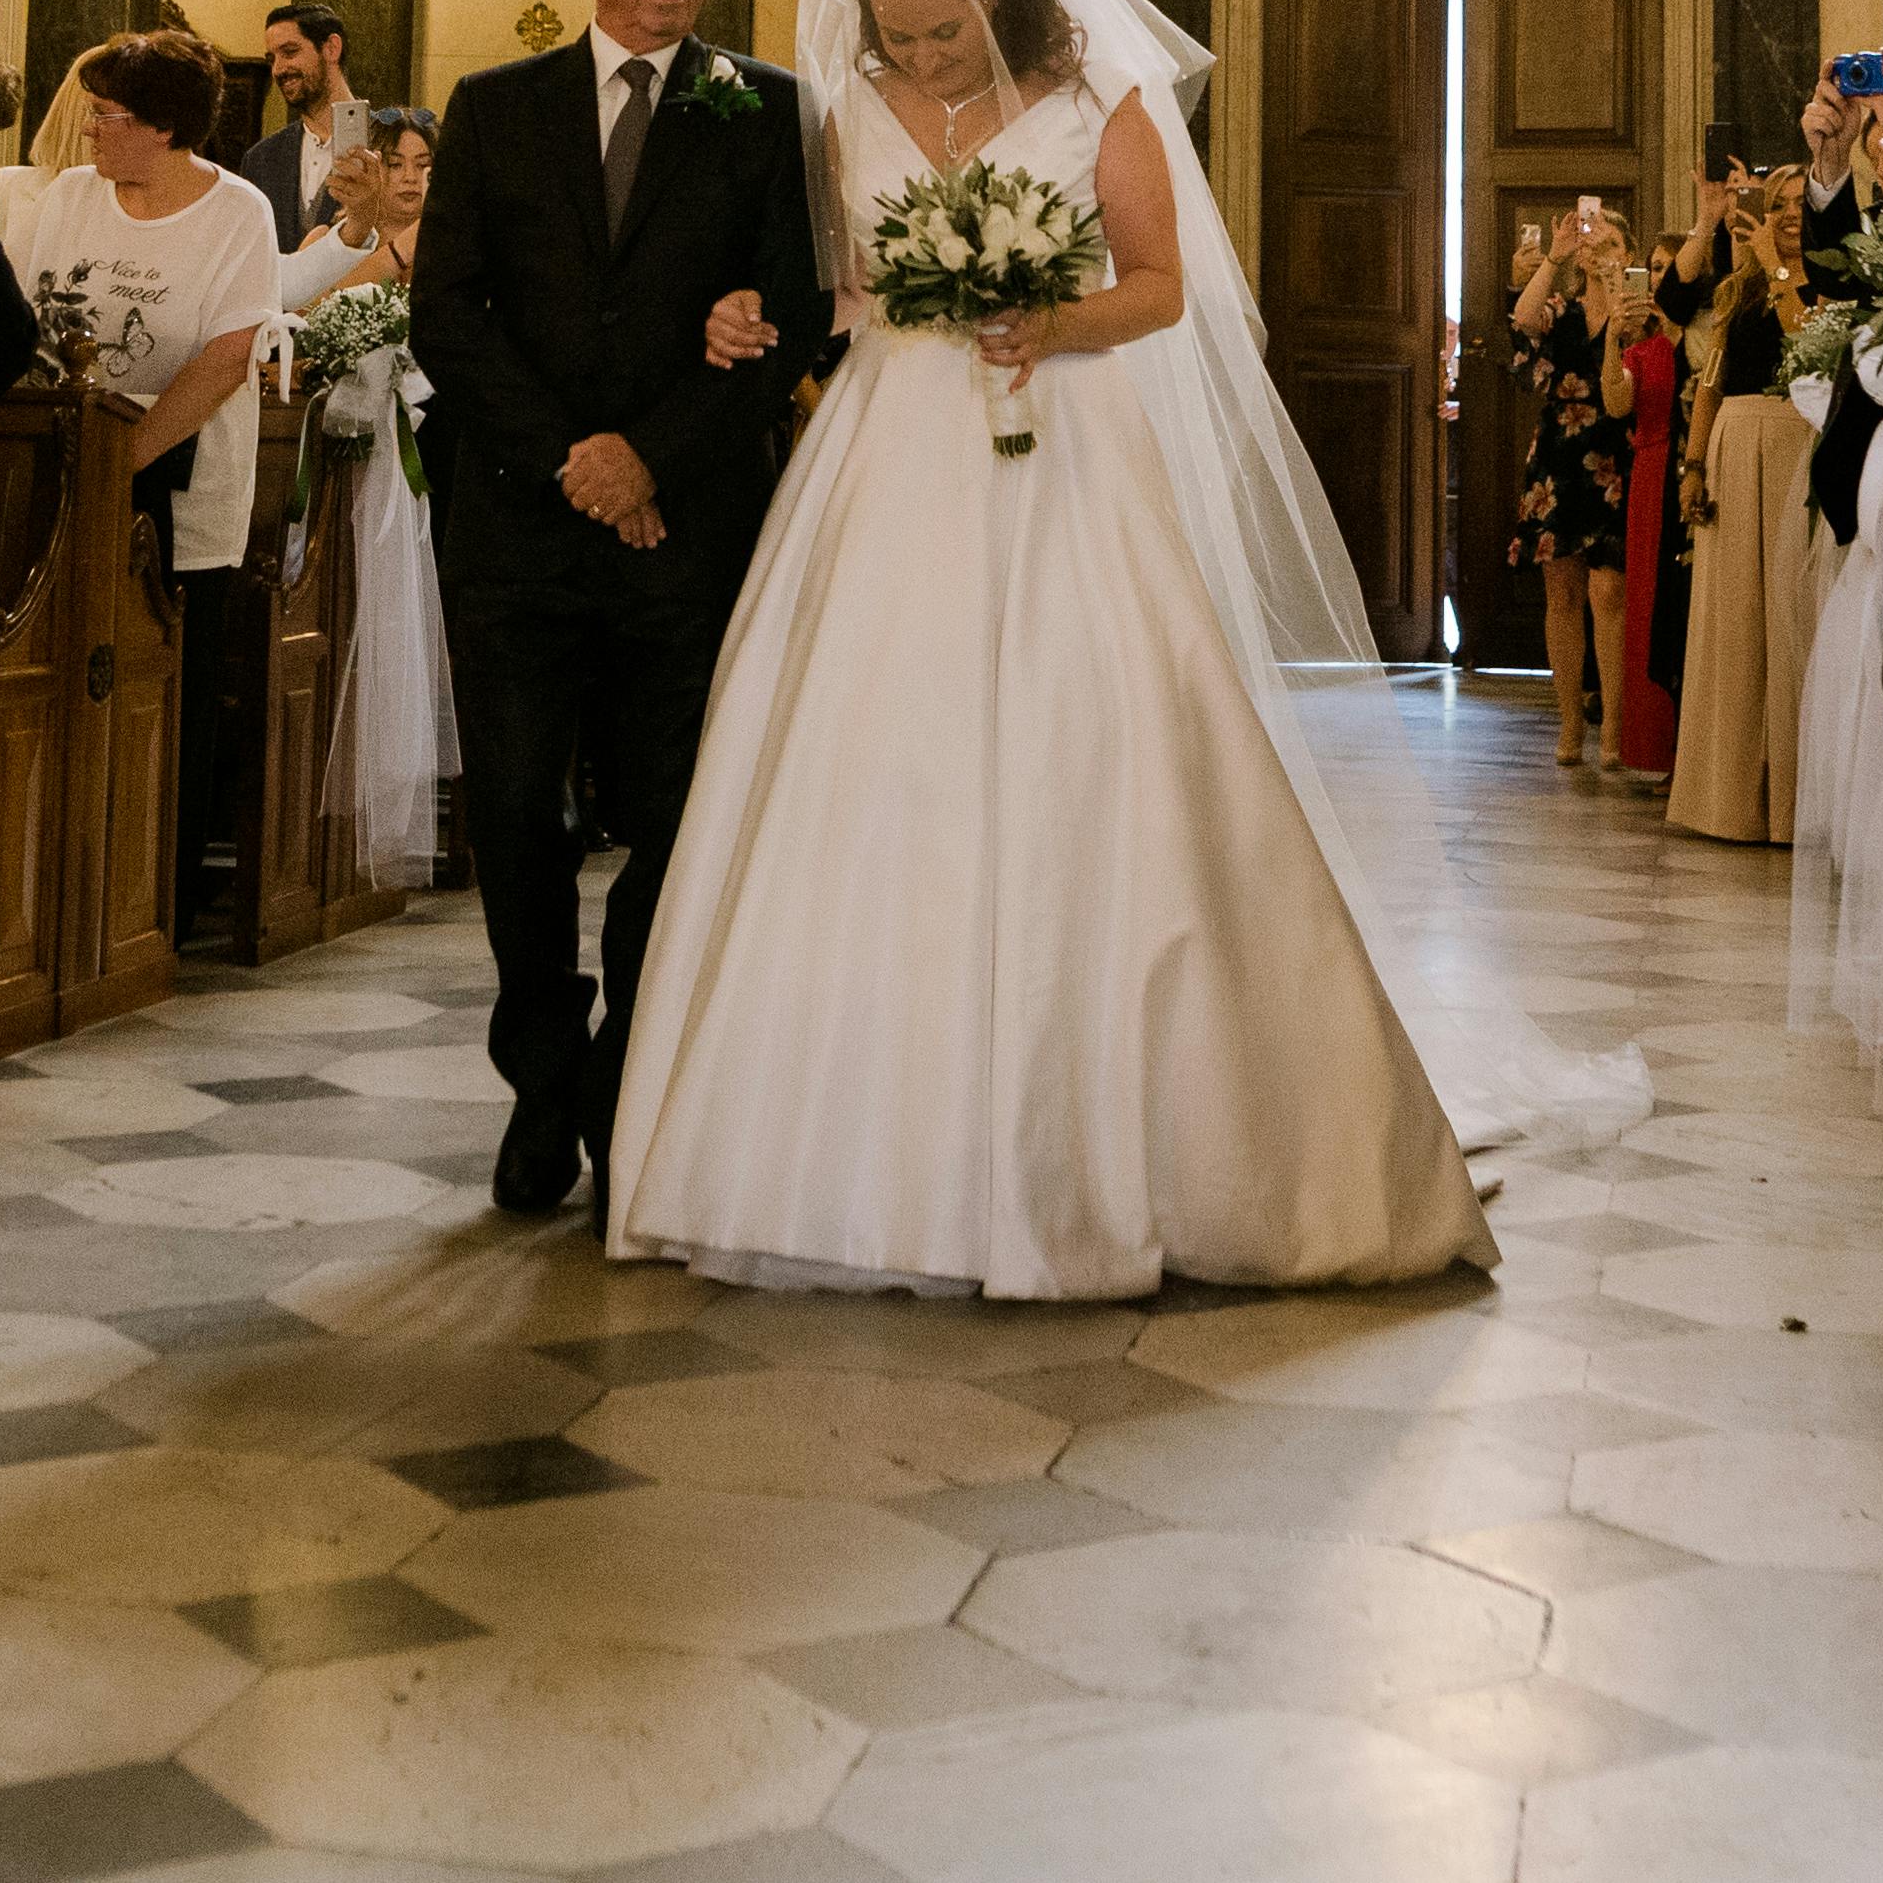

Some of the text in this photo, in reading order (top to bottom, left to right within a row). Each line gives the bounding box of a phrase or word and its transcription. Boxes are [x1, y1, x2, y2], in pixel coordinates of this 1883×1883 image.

[94, 259, 161, 280] Nice to
[108, 284, 171, 305] meet
